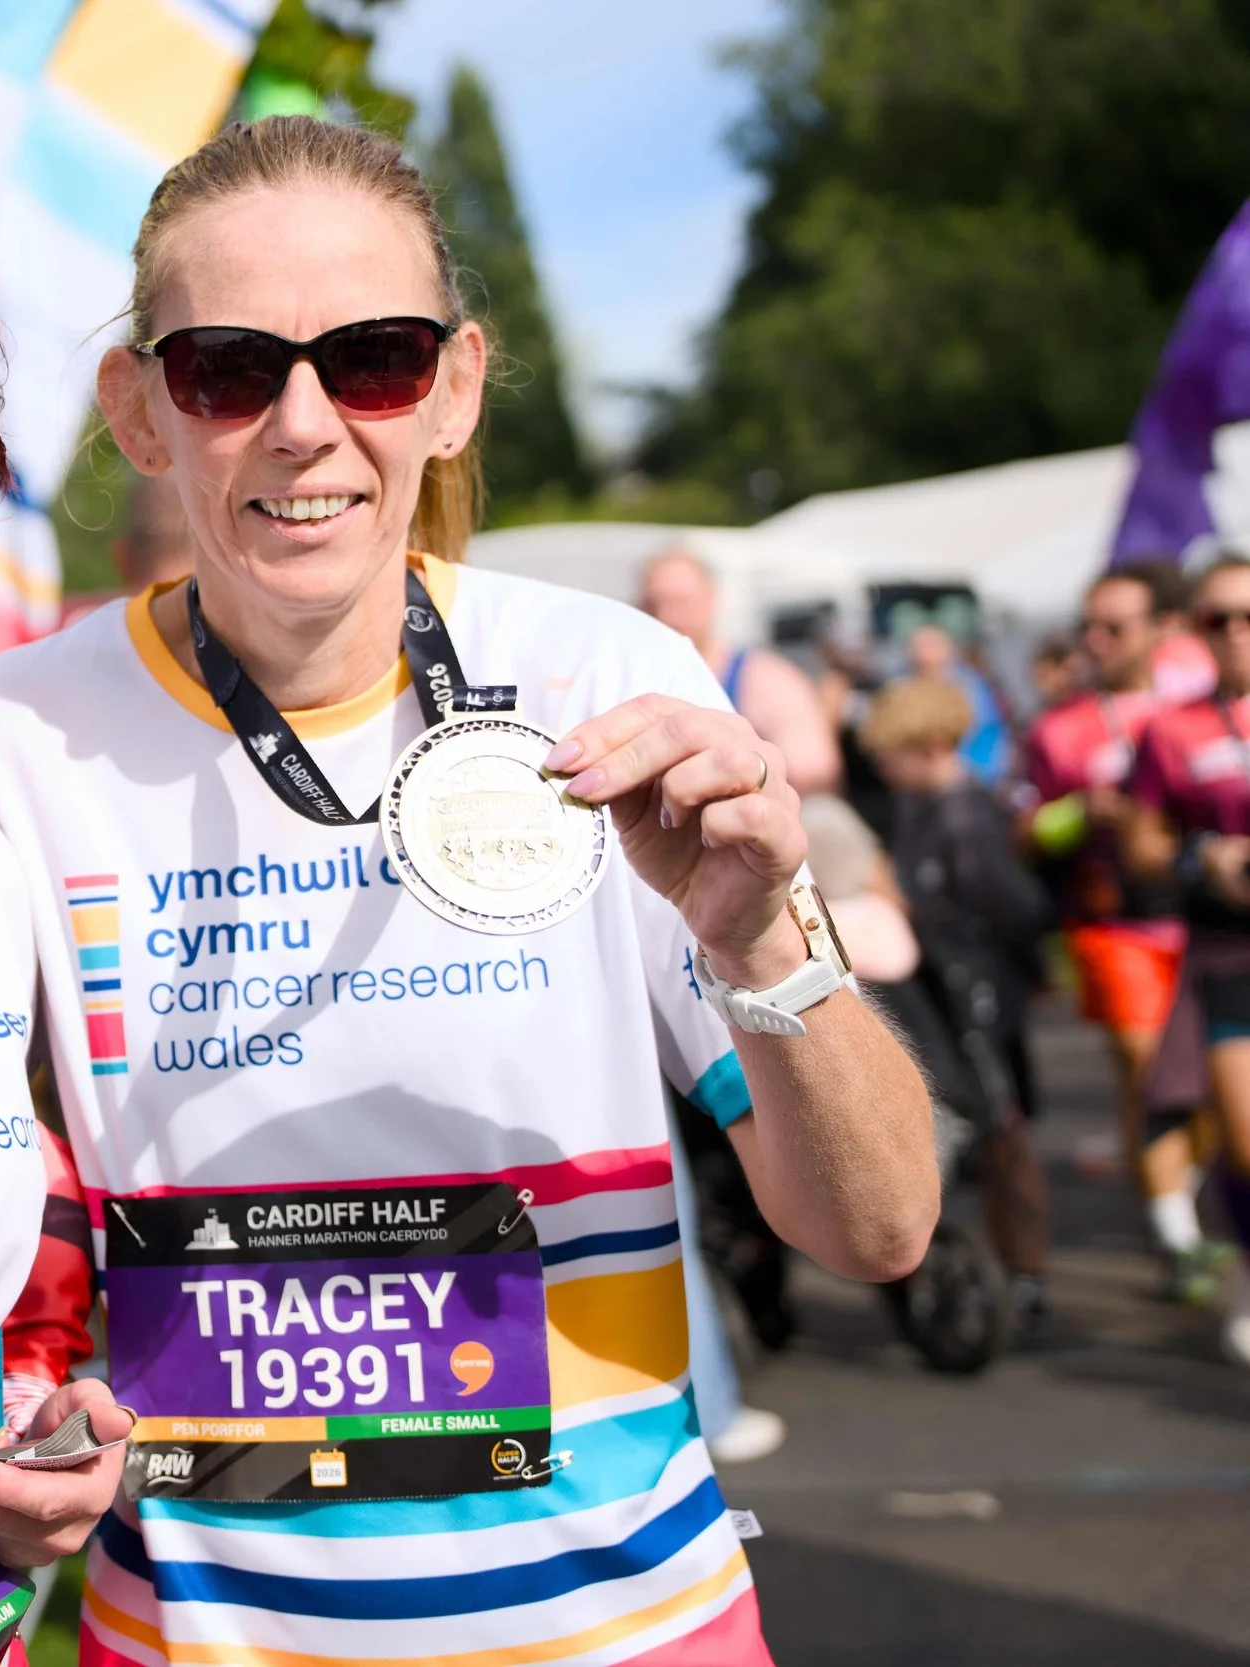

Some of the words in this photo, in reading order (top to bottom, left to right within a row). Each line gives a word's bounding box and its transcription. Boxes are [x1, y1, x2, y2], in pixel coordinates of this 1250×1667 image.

[281, 753, 325, 798] CARDIFF
[312, 797, 346, 821] HALF
[148, 846, 370, 913] ymchwil
[146, 917, 310, 966] cymru
[149, 970, 322, 1016] cancer
[334, 948, 550, 1004] research
[154, 1025, 304, 1073] wales
[246, 1201, 364, 1230] CARDIFF
[372, 1199, 446, 1225] HALF
[248, 1233, 301, 1248] HANNER
[304, 1230, 377, 1245] MARATHON
[379, 1227, 448, 1243] CAERDYDD
[181, 1271, 457, 1338] TRACEY
[219, 1341, 425, 1409] 19391
[171, 1421, 198, 1437] PEN
[201, 1421, 266, 1437] PORFFOR
[381, 1416, 443, 1433] FEMALE
[445, 1414, 500, 1430] SMALL
[315, 1466, 341, 1478] 2026
